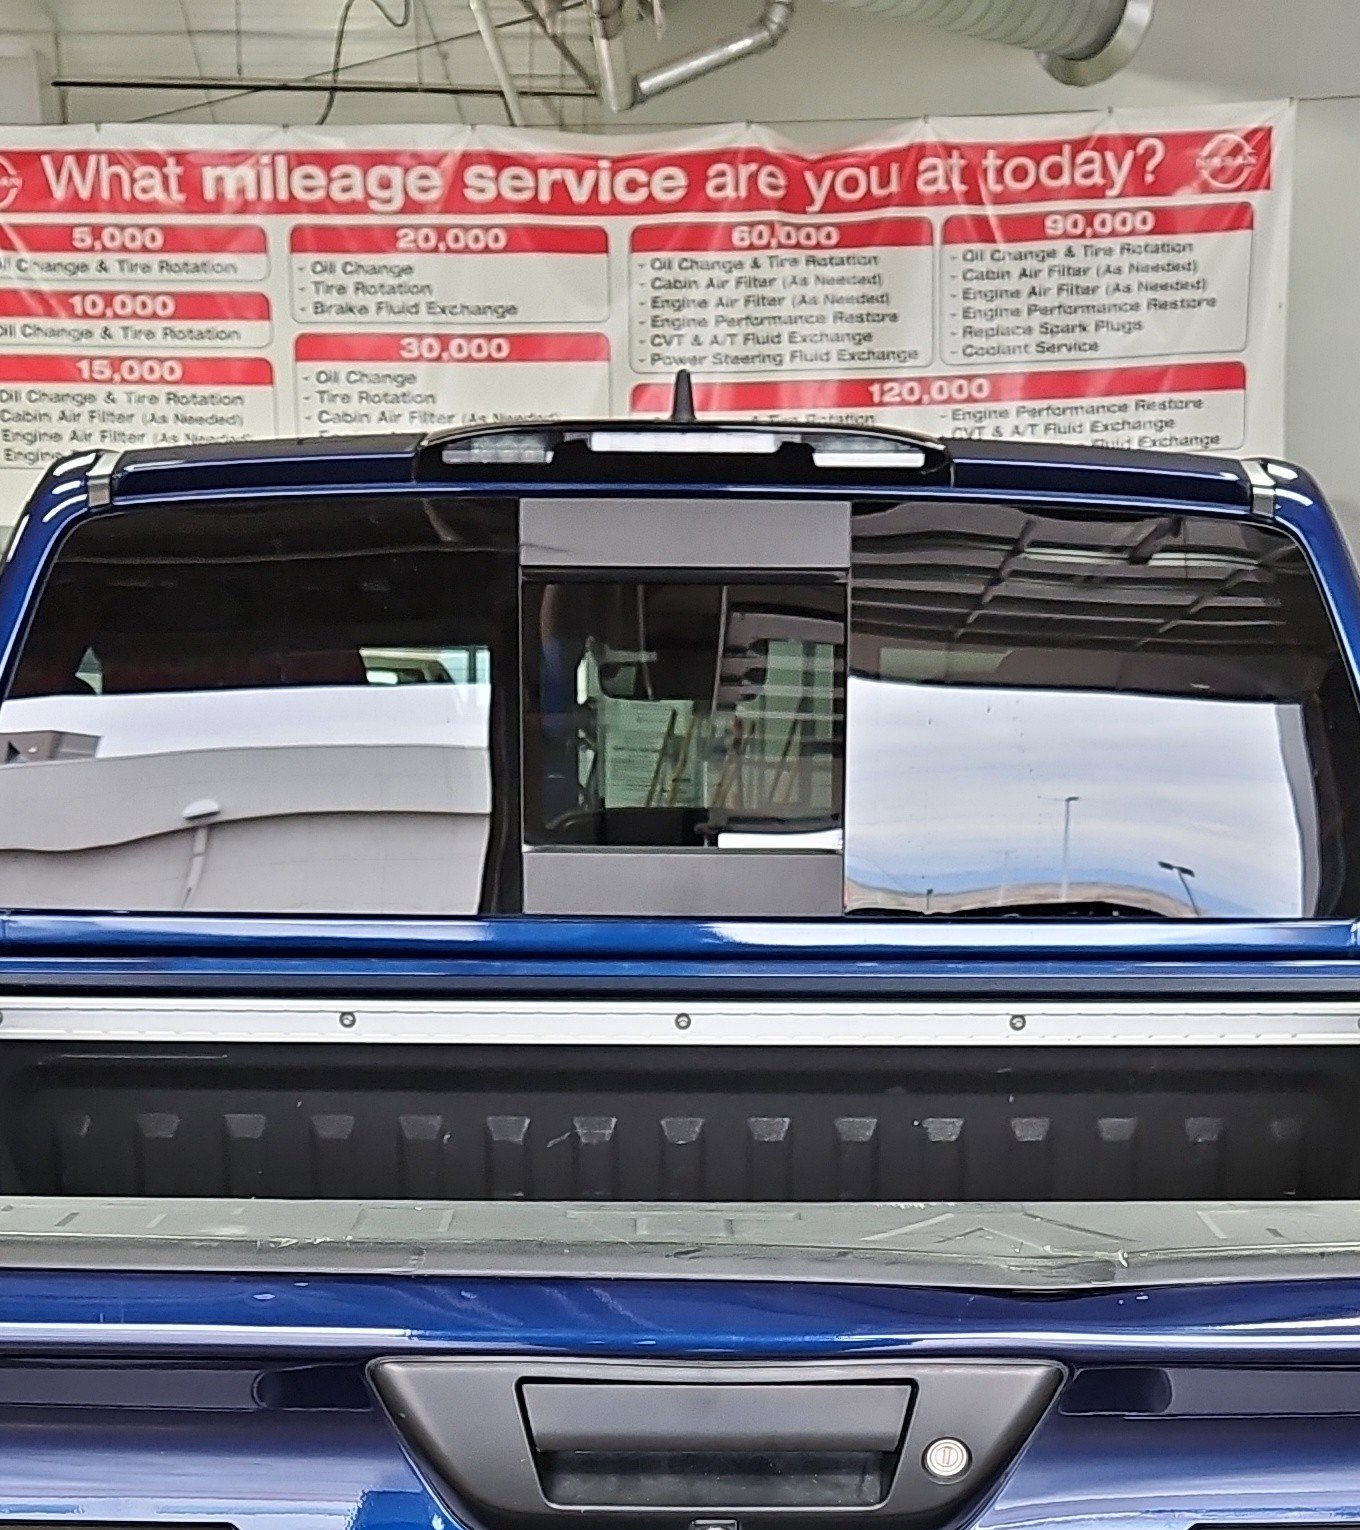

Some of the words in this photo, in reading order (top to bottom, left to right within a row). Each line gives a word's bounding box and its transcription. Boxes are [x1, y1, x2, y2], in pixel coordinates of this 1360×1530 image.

[40, 153, 186, 201] What
[201, 154, 443, 212] mileage
[463, 159, 688, 205] service
[705, 162, 787, 199] are
[805, 162, 900, 211] you
[915, 152, 968, 192] at
[983, 137, 1166, 197] today?
[731, 223, 841, 249] 60,000
[1043, 210, 1156, 237] 90,000
[71, 227, 164, 251] 5,000
[396, 227, 508, 252] 20,000
[95, 260, 109, 274] &
[311, 261, 337, 275] Oil
[341, 261, 414, 278] Change
[69, 293, 177, 318] 10,000
[400, 337, 510, 361] 30,000
[76, 359, 183, 384] 15,000
[868, 378, 991, 403] 120,000
